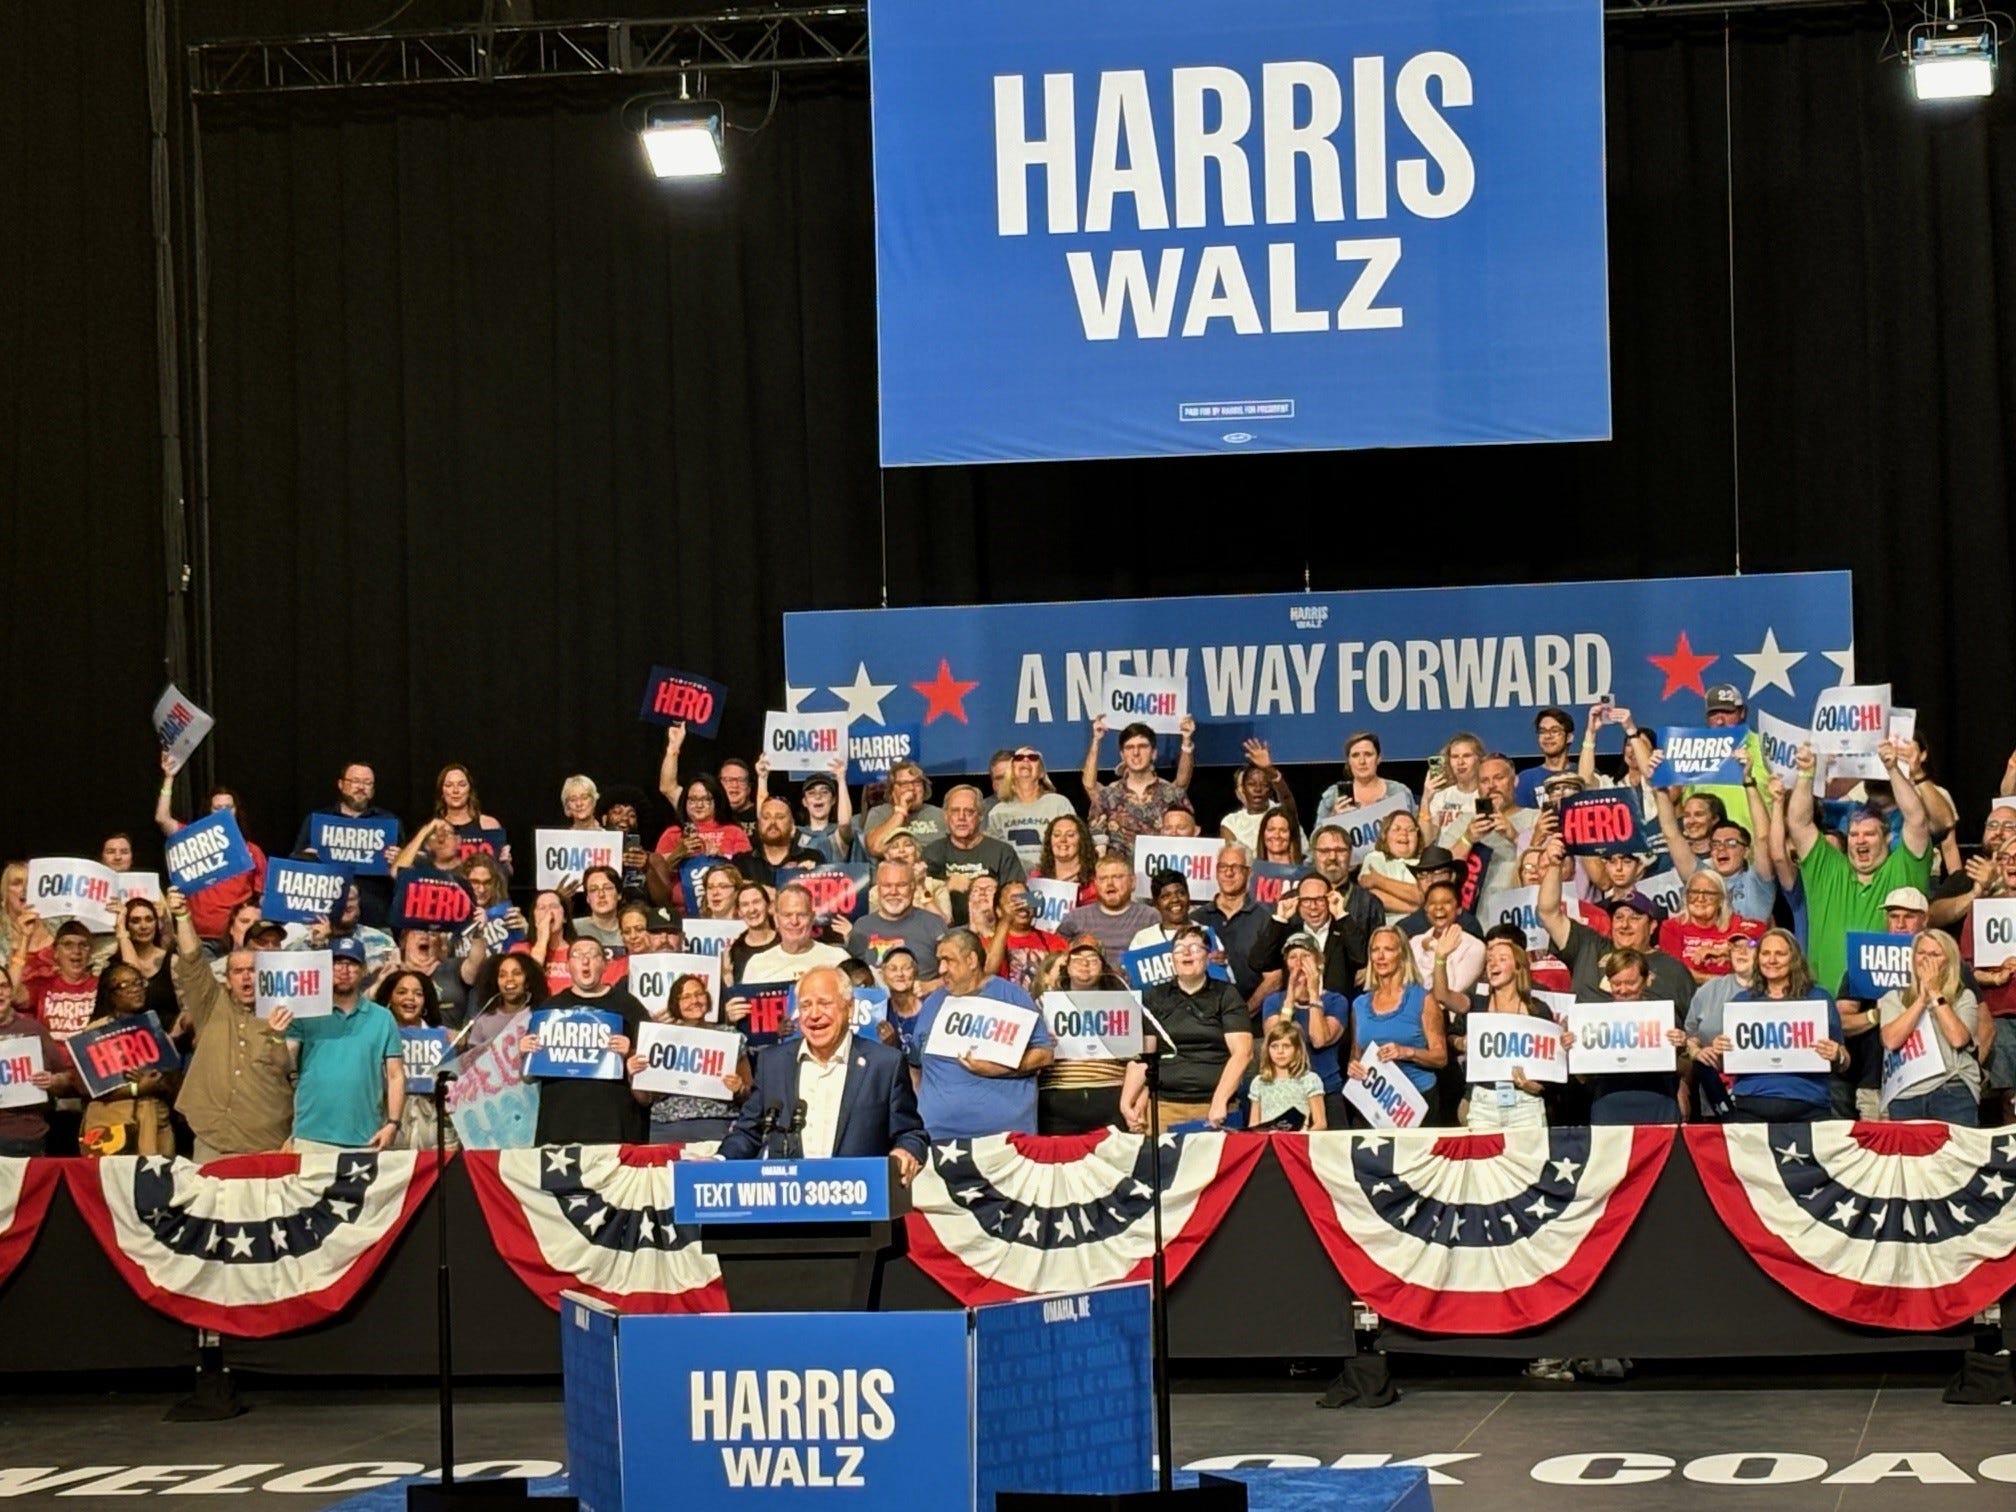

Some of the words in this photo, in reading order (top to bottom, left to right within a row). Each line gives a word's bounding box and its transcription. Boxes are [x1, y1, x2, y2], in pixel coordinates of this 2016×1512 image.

[994, 51, 1475, 236] HARRIS
[1066, 237, 1403, 340] WALZ
[1290, 606, 1329, 621] HARRIS
[1014, 654, 1053, 724] A
[1201, 643, 1326, 716] WAY
[1337, 633, 1612, 712] FORWARD
[653, 681, 714, 724] HERO
[1111, 690, 1177, 716] COACH!
[1815, 704, 1882, 732] COACH!
[773, 729, 836, 752] COACH!
[850, 734, 911, 758] HARRIS
[1666, 737, 1734, 758] HARRIS
[1763, 732, 1797, 769] COAC
[1675, 759, 1720, 773] WALZ
[321, 825, 385, 851] HARRIS
[1564, 804, 1633, 844] HERO
[169, 825, 229, 873] HARRIS
[330, 850, 374, 864] WALZ
[546, 847, 611, 871] COACH!
[179, 854, 227, 882] WALZ
[38, 874, 109, 900] COACH!
[278, 870, 344, 898] HARRIS
[286, 896, 333, 912] WALZ
[405, 882, 471, 922] HERO
[1137, 952, 1178, 985] HAR
[1860, 945, 1911, 972] HARR
[258, 969, 320, 996] COACH!
[1871, 972, 1911, 987] WAL
[539, 1021, 611, 1048] HARRIS
[944, 1012, 1020, 1046] COACH!
[1054, 1010, 1129, 1037] COACH!
[1581, 1021, 1661, 1049] COACH!
[1736, 1021, 1814, 1049] COACH!
[86, 1029, 160, 1079] HERO
[548, 1048, 599, 1063] WALZ
[649, 1043, 725, 1077] COACH!
[1479, 1032, 1556, 1060] COACH!
[1362, 1066, 1415, 1128] COACH!
[693, 1183, 733, 1208] TEXT
[737, 1182, 776, 1206] WIN
[780, 1181, 801, 1206] TO
[804, 1180, 868, 1206] 30330
[1043, 1298, 1078, 1324] OMAHA,
[1078, 1296, 1091, 1317] NE
[690, 1368, 895, 1442] HARRIS
[721, 1446, 865, 1488] WALZ
